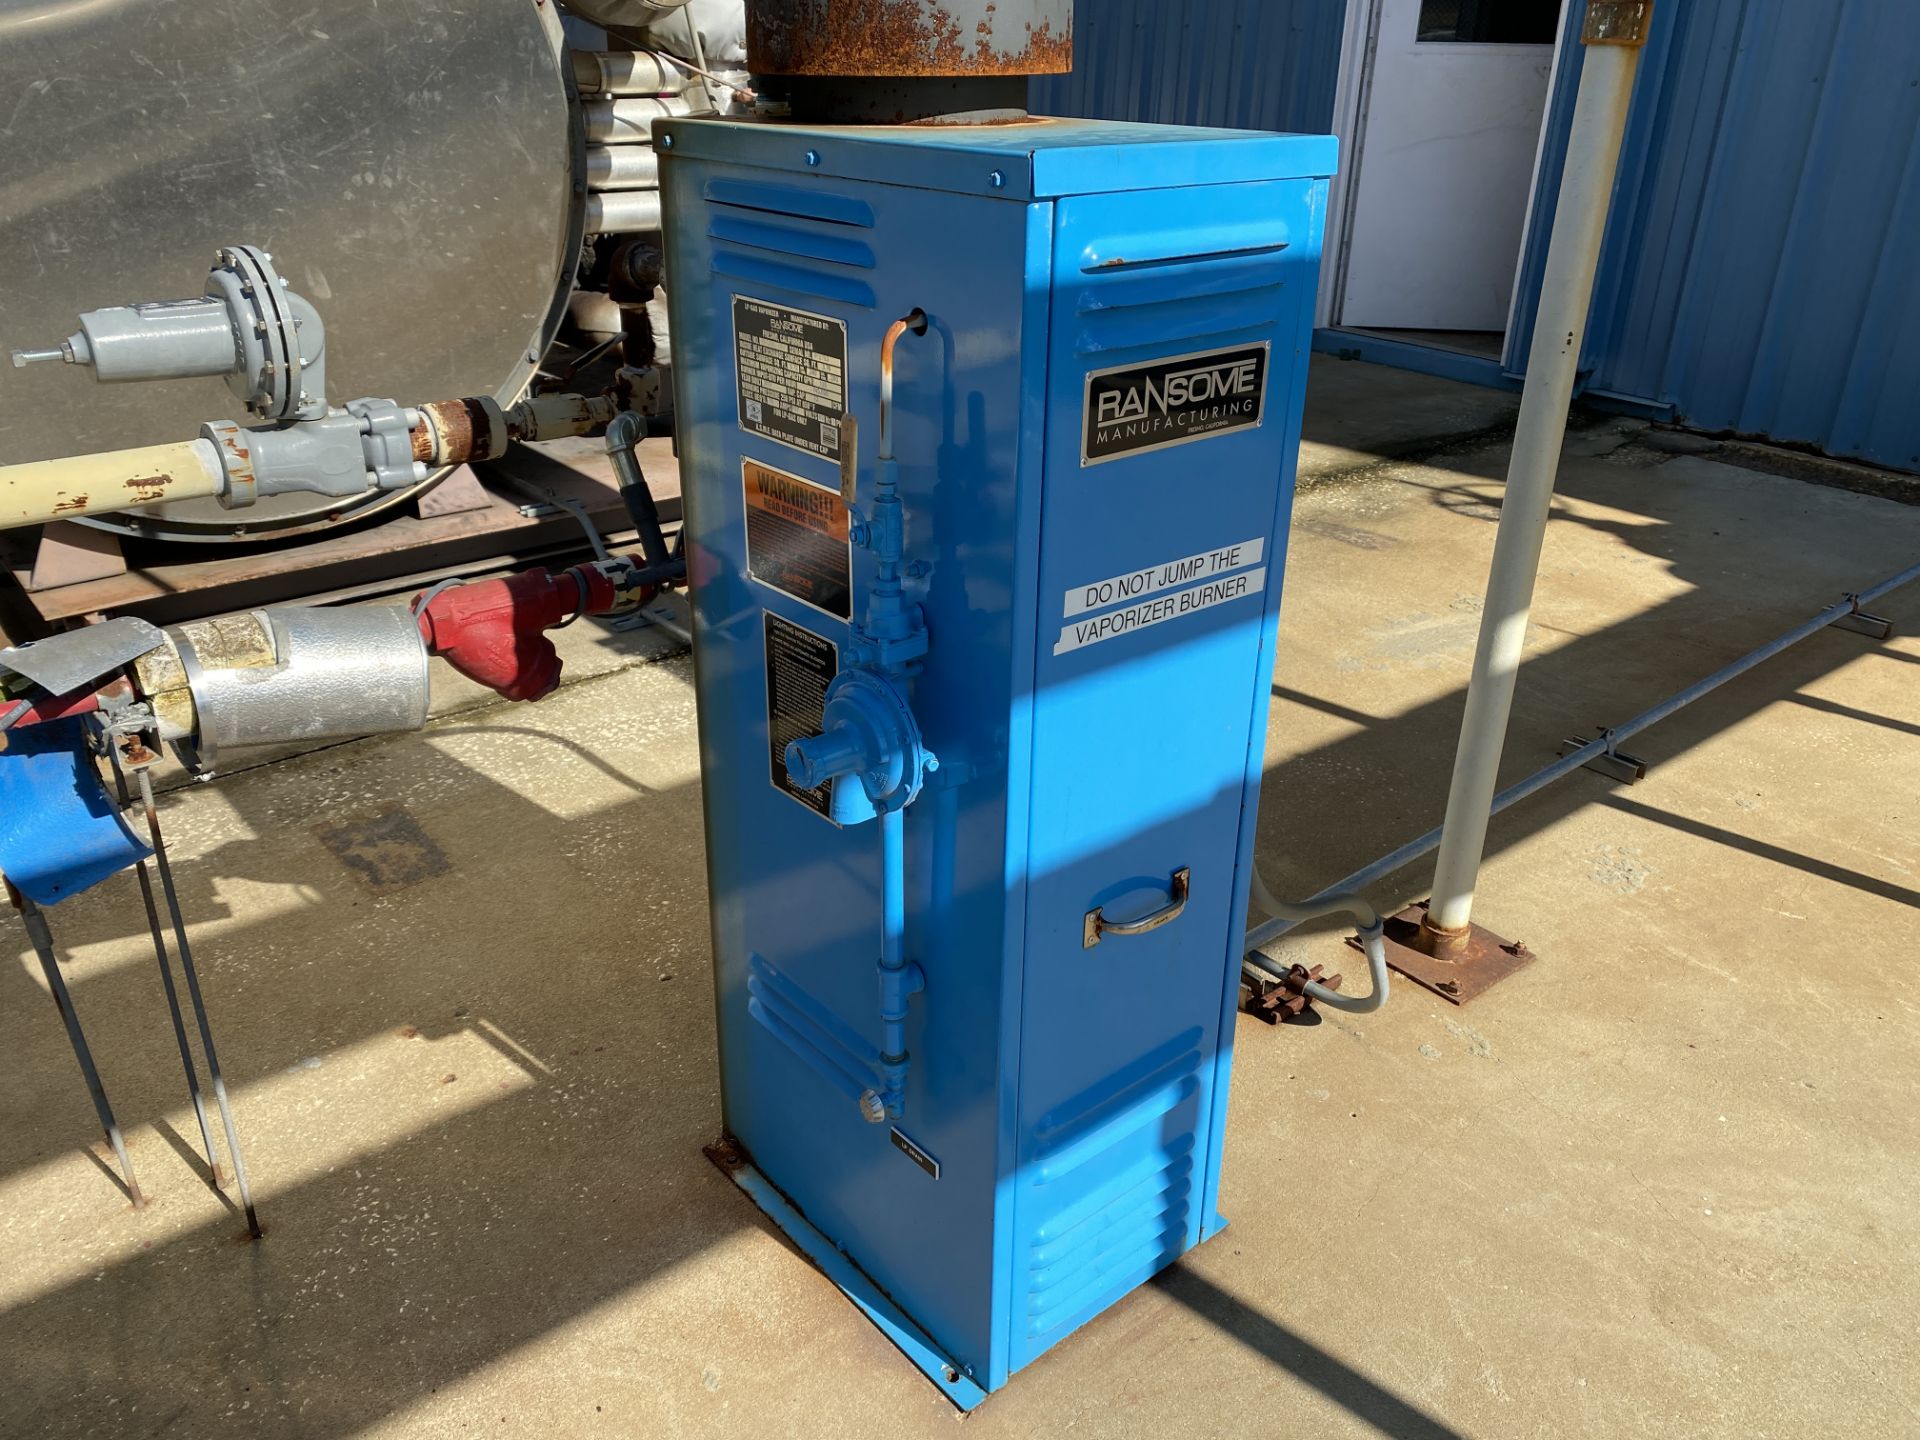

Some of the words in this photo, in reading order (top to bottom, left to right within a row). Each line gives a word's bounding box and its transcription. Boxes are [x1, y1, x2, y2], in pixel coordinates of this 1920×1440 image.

[1096, 399, 1252, 444] MANUFACTURING
[1097, 358, 1256, 428] RANSOME
[1086, 583, 1113, 608] DO
[1118, 571, 1154, 599] NOT
[1159, 557, 1204, 587] JUMP
[1209, 547, 1241, 572] THE
[1076, 598, 1174, 644] VAPORIZER
[1180, 577, 1247, 612] BURNER
